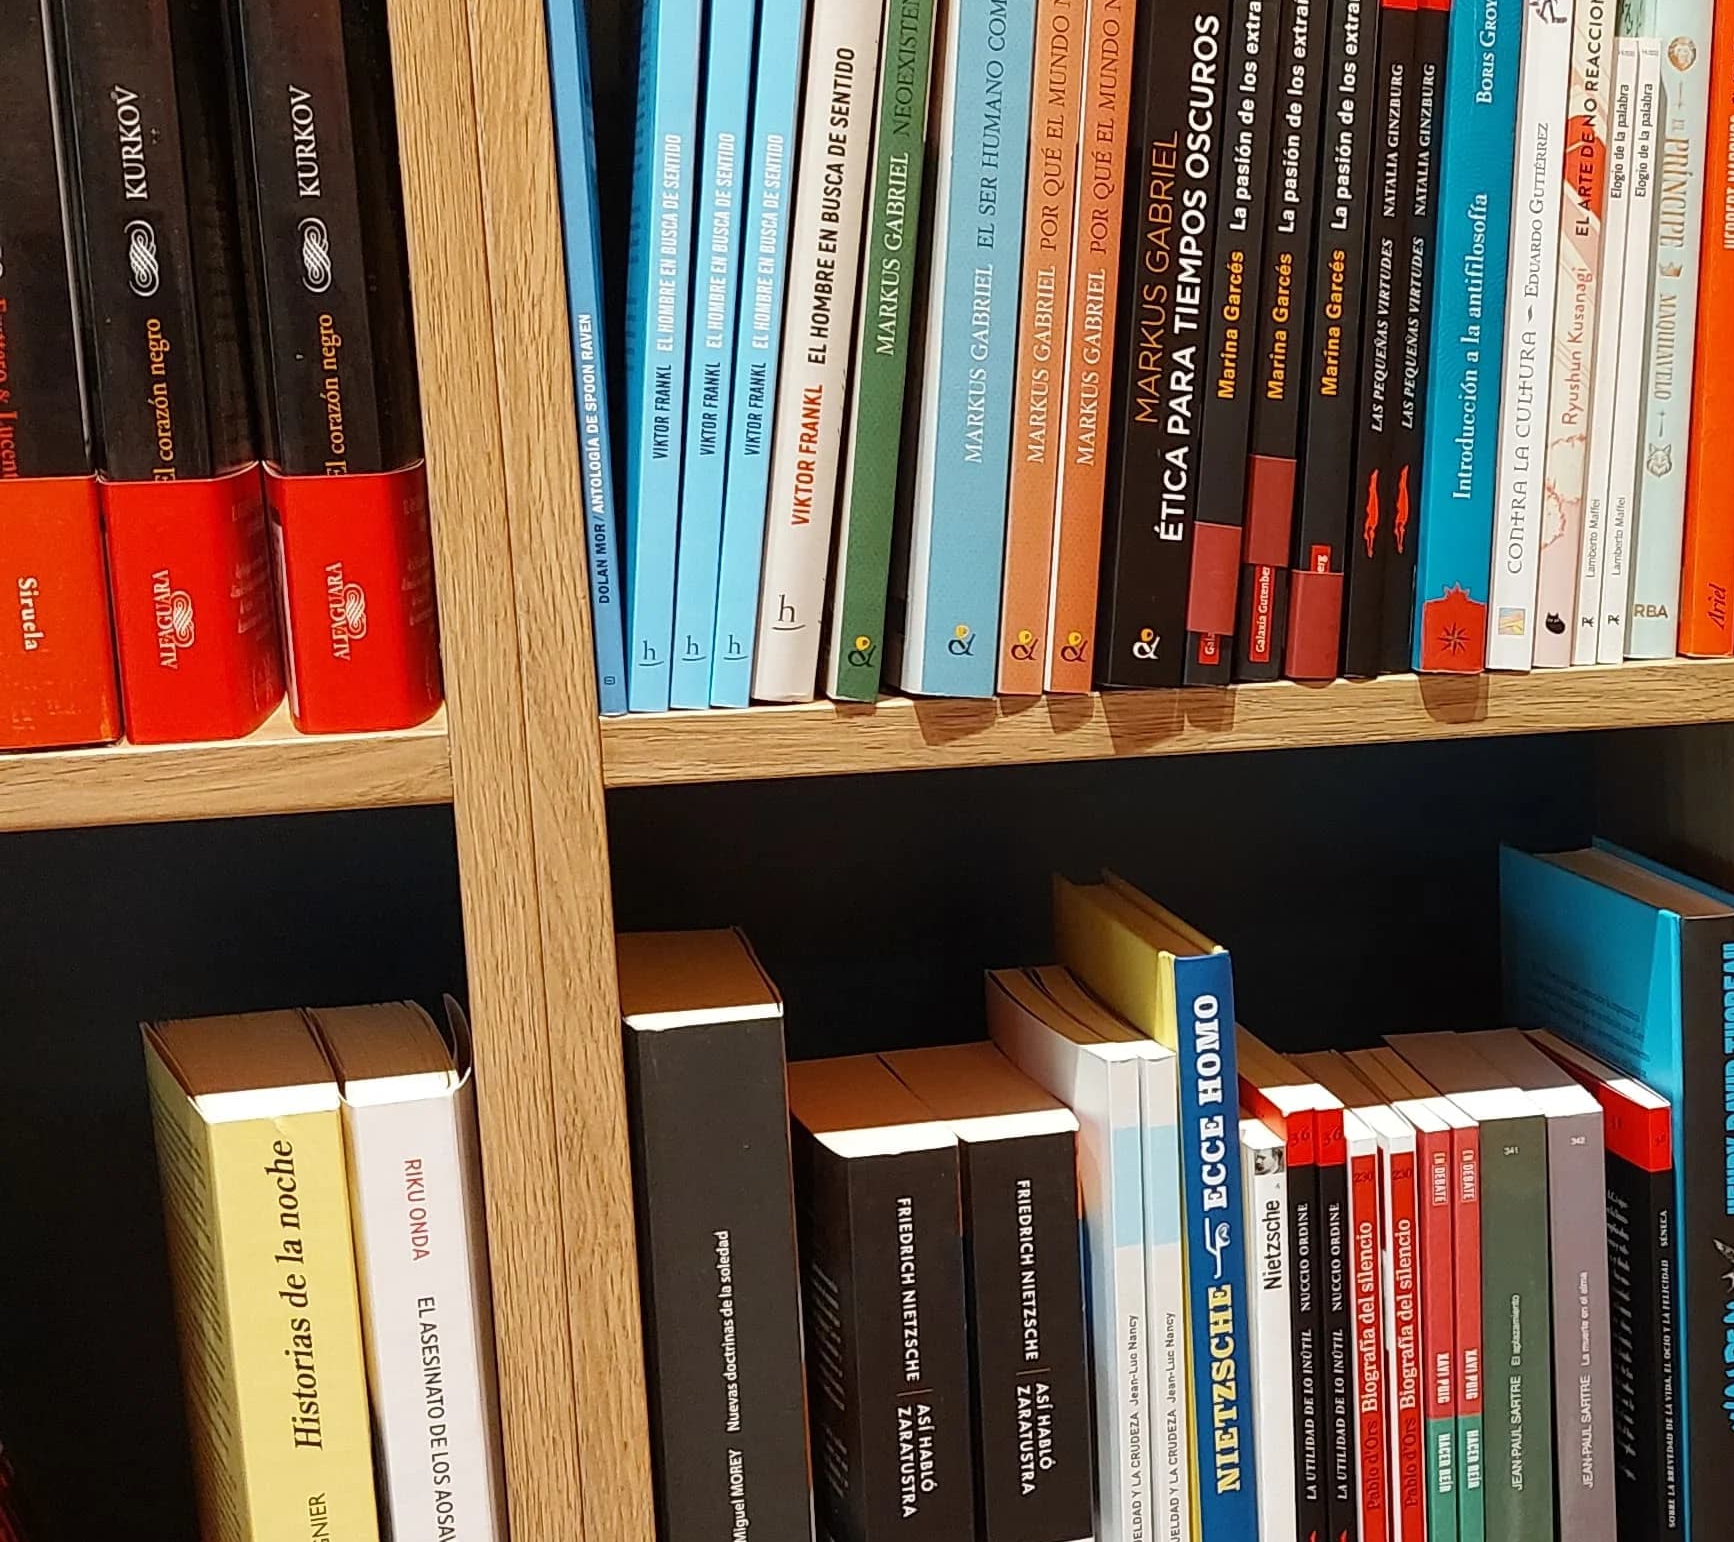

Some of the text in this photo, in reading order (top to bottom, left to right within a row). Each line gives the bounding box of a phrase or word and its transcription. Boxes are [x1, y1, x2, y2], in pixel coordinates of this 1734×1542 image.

[289, 85, 320, 196] KURKOV
[791, 47, 854, 524] VIKTOR FRANKL EL HOMBRE EN BUSCA DE SENTIDO
[1134, 130, 1177, 422] MARKUS GABRIEL
[1153, 15, 1219, 540] ÉTICA PARA TIEMPOS OSCUROS
[1464, 194, 1487, 317] antifilosofía
[1460, 325, 1480, 344] la
[1466, 351, 1478, 362] a
[1452, 370, 1477, 498] Introducción
[404, 1158, 425, 1201] RIKU
[409, 1207, 429, 1260] ONDA
[263, 1140, 322, 1448] Historias de la noche
[1194, 995, 1239, 1492] NIETZSCHE ECCE HOMO
[417, 1296, 435, 1318] EL
[1356, 1222, 1379, 1412] Biografía del silencio
[419, 1322, 444, 1418] ASESINATO
[429, 1423, 447, 1448] DE
[431, 1451, 450, 1485] LOS
